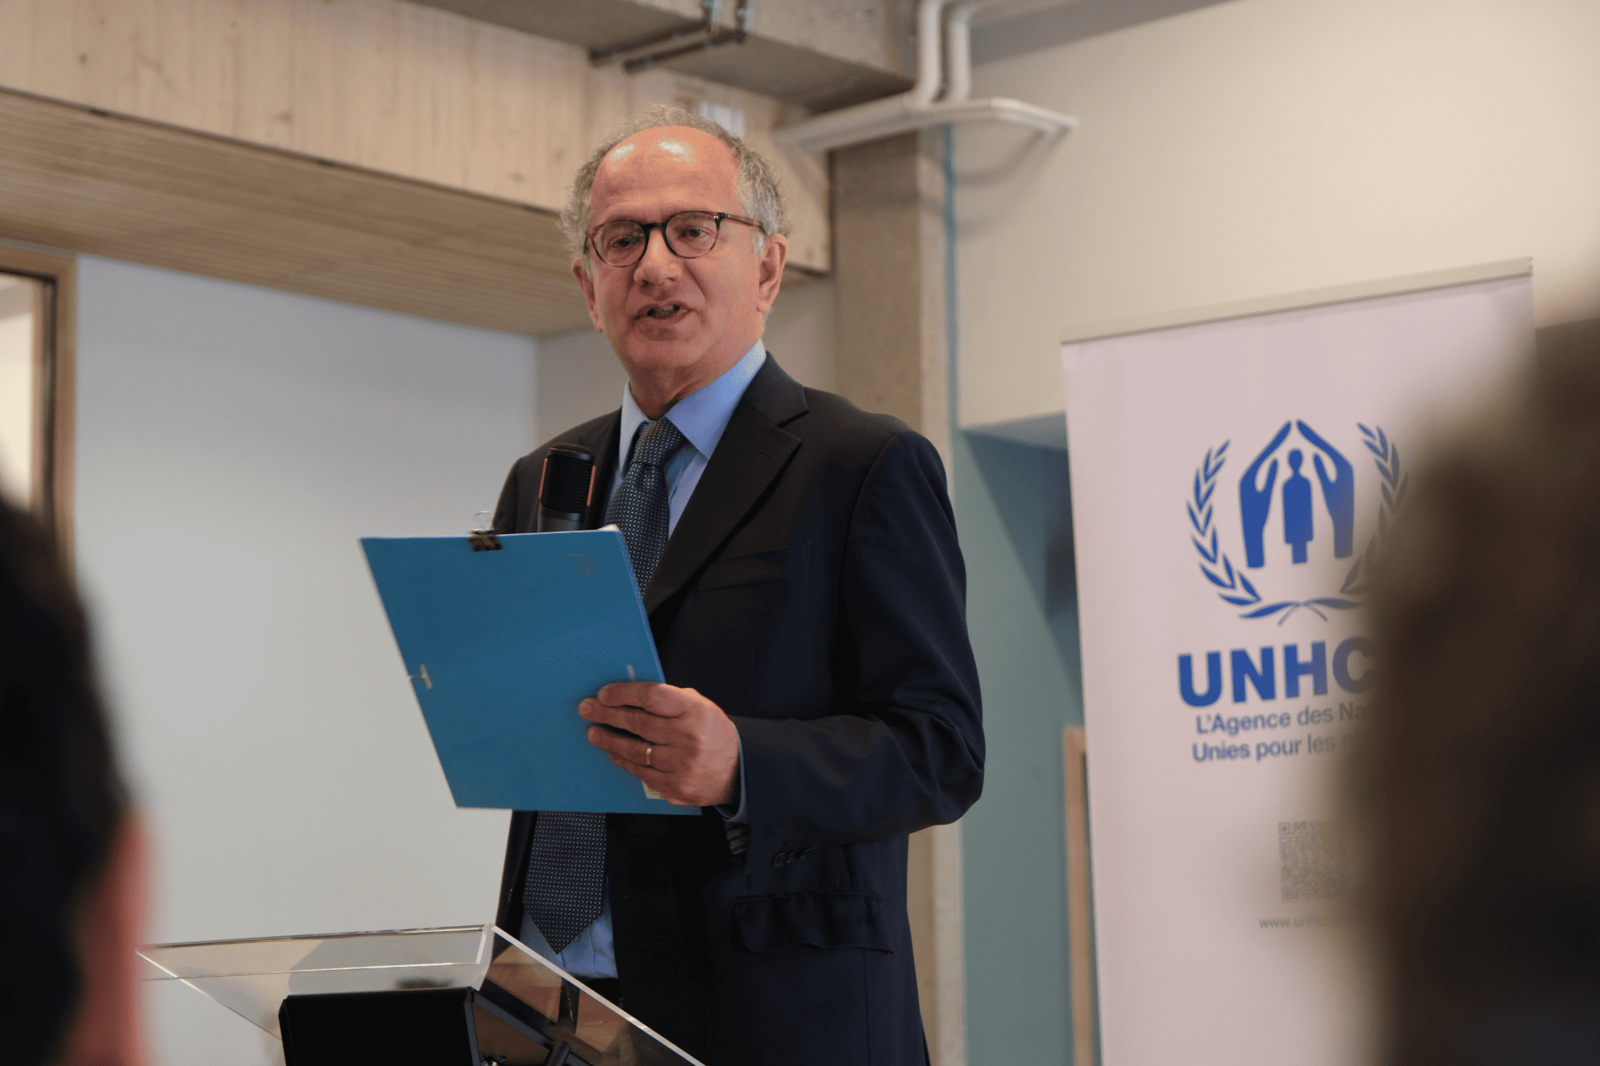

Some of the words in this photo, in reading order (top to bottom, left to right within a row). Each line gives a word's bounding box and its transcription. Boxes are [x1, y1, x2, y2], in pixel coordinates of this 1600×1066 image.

[1178, 636, 1377, 707] UNHC
[1196, 712, 1291, 736] L'Agence
[1297, 705, 1333, 725] des
[1192, 740, 1251, 763] Unies
[1256, 738, 1302, 762] pour
[1307, 733, 1336, 754] les
